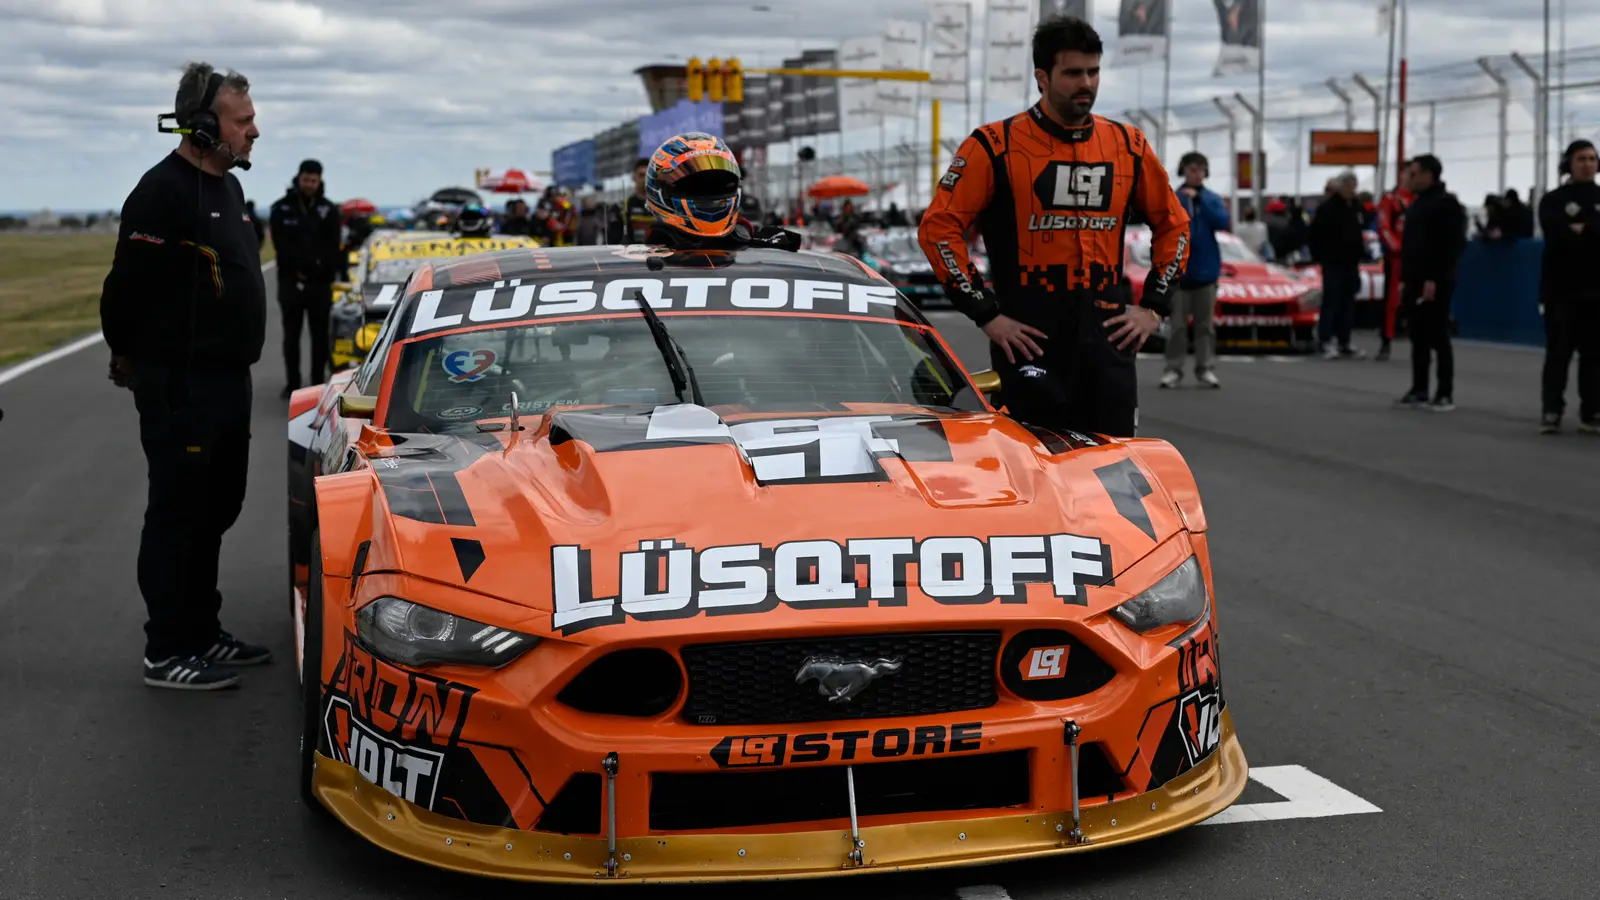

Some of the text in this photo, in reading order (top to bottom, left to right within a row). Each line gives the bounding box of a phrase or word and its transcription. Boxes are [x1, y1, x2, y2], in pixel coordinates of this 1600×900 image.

[409, 277, 897, 334] LÜSQTOFF
[551, 534, 1108, 630] LÜSQTOFF
[335, 640, 468, 746] IRON
[790, 722, 983, 763] STORE
